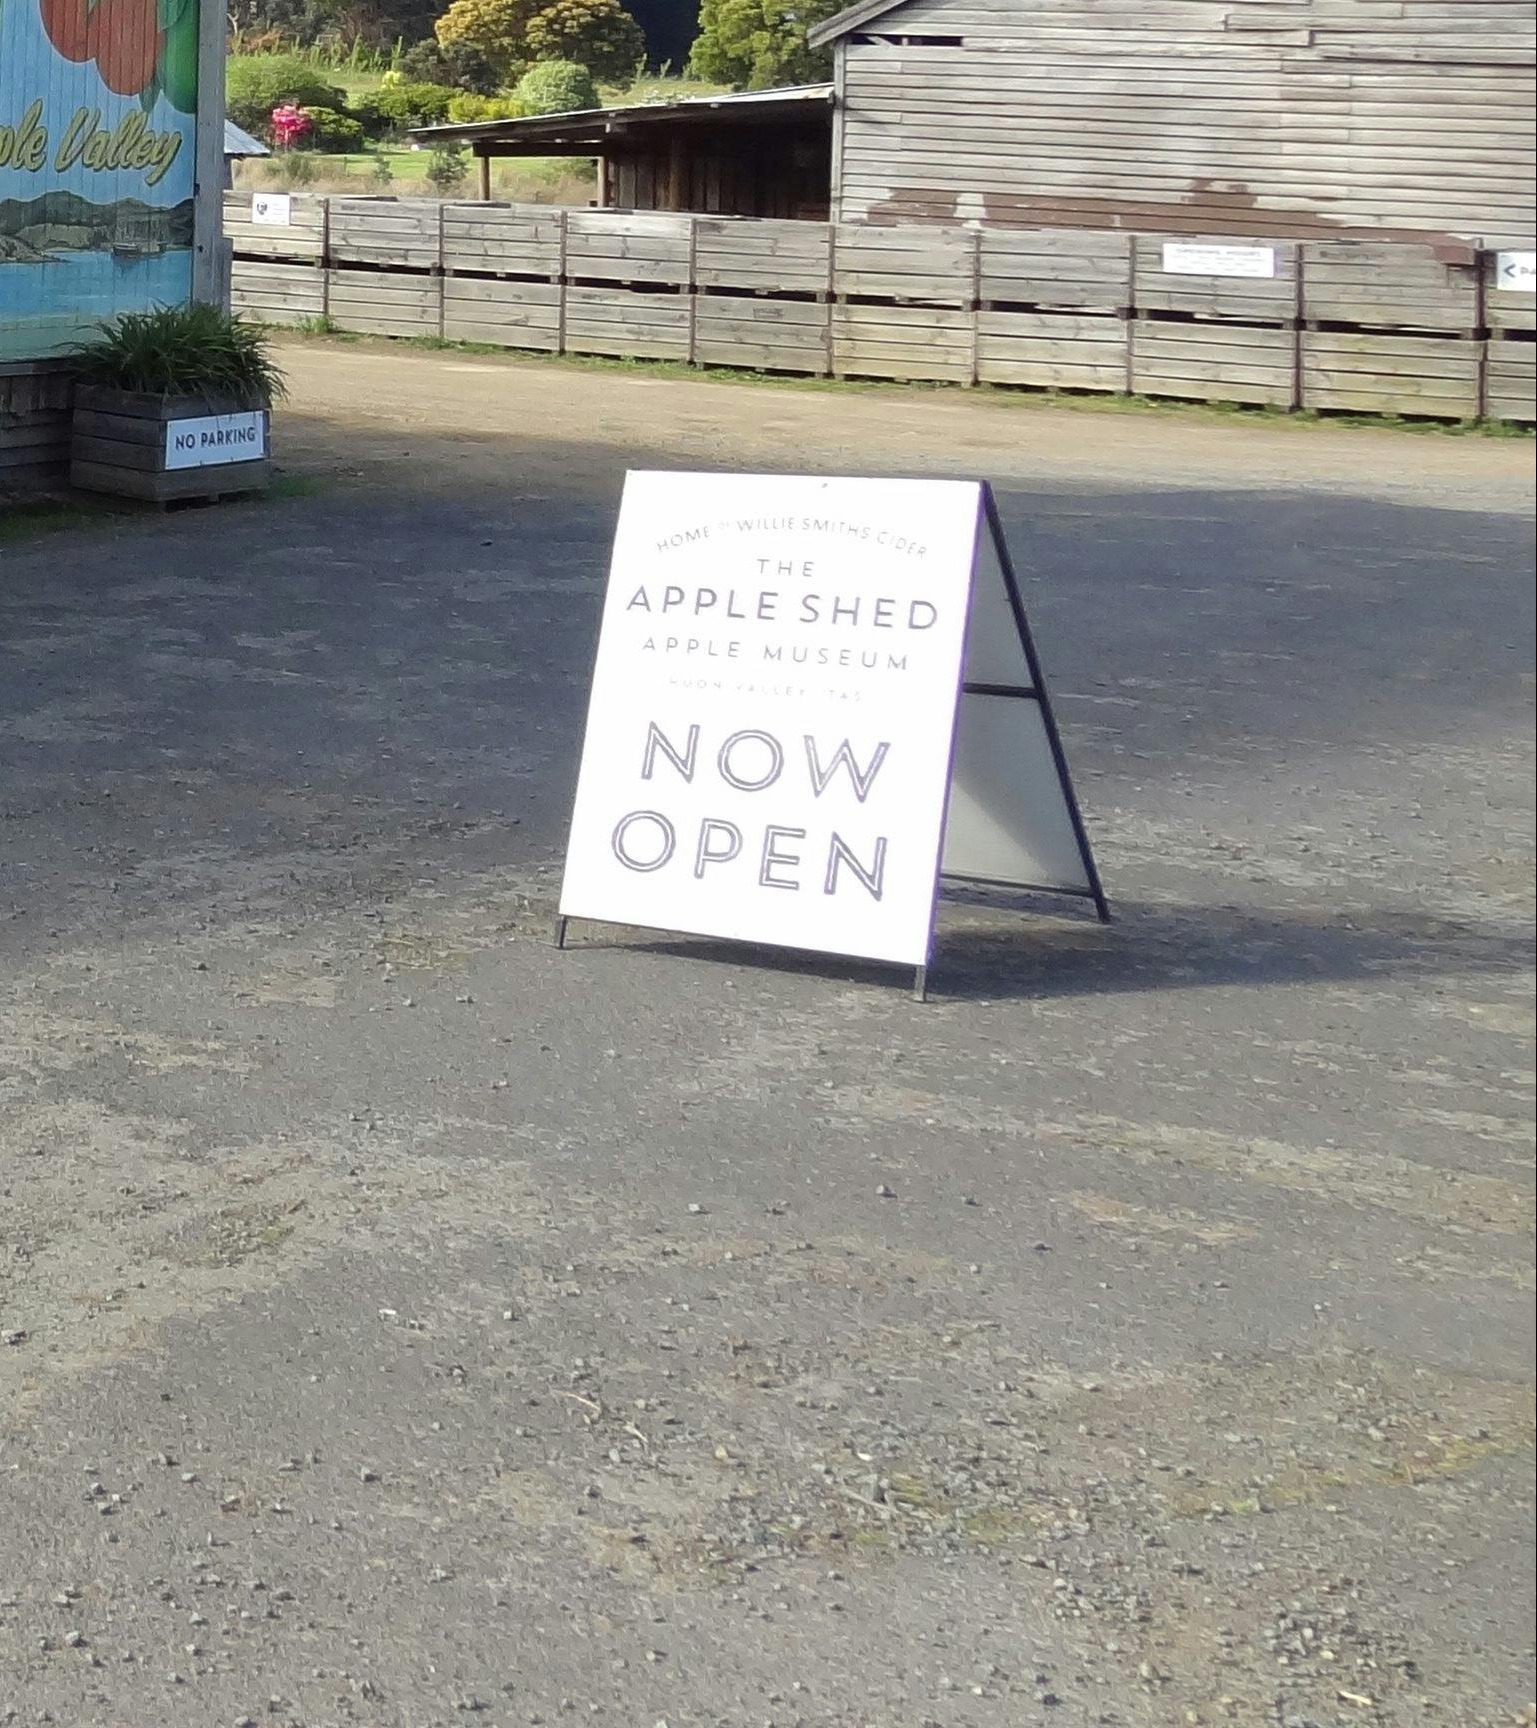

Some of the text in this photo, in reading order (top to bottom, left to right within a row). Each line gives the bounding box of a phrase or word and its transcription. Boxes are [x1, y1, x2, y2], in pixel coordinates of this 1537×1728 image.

[54, 106, 183, 187] Valley
[175, 426, 257, 451] NO PARKING
[655, 525, 711, 553] HOME
[736, 516, 795, 532] WILLIE
[801, 517, 871, 540] SMITHS
[876, 530, 928, 559] CIDER
[755, 558, 816, 578] THE
[626, 583, 939, 631] APPLE SHED
[641, 636, 909, 671] APPLE MUSEUM
[640, 719, 893, 805] NOW
[611, 808, 889, 903] OPEN
